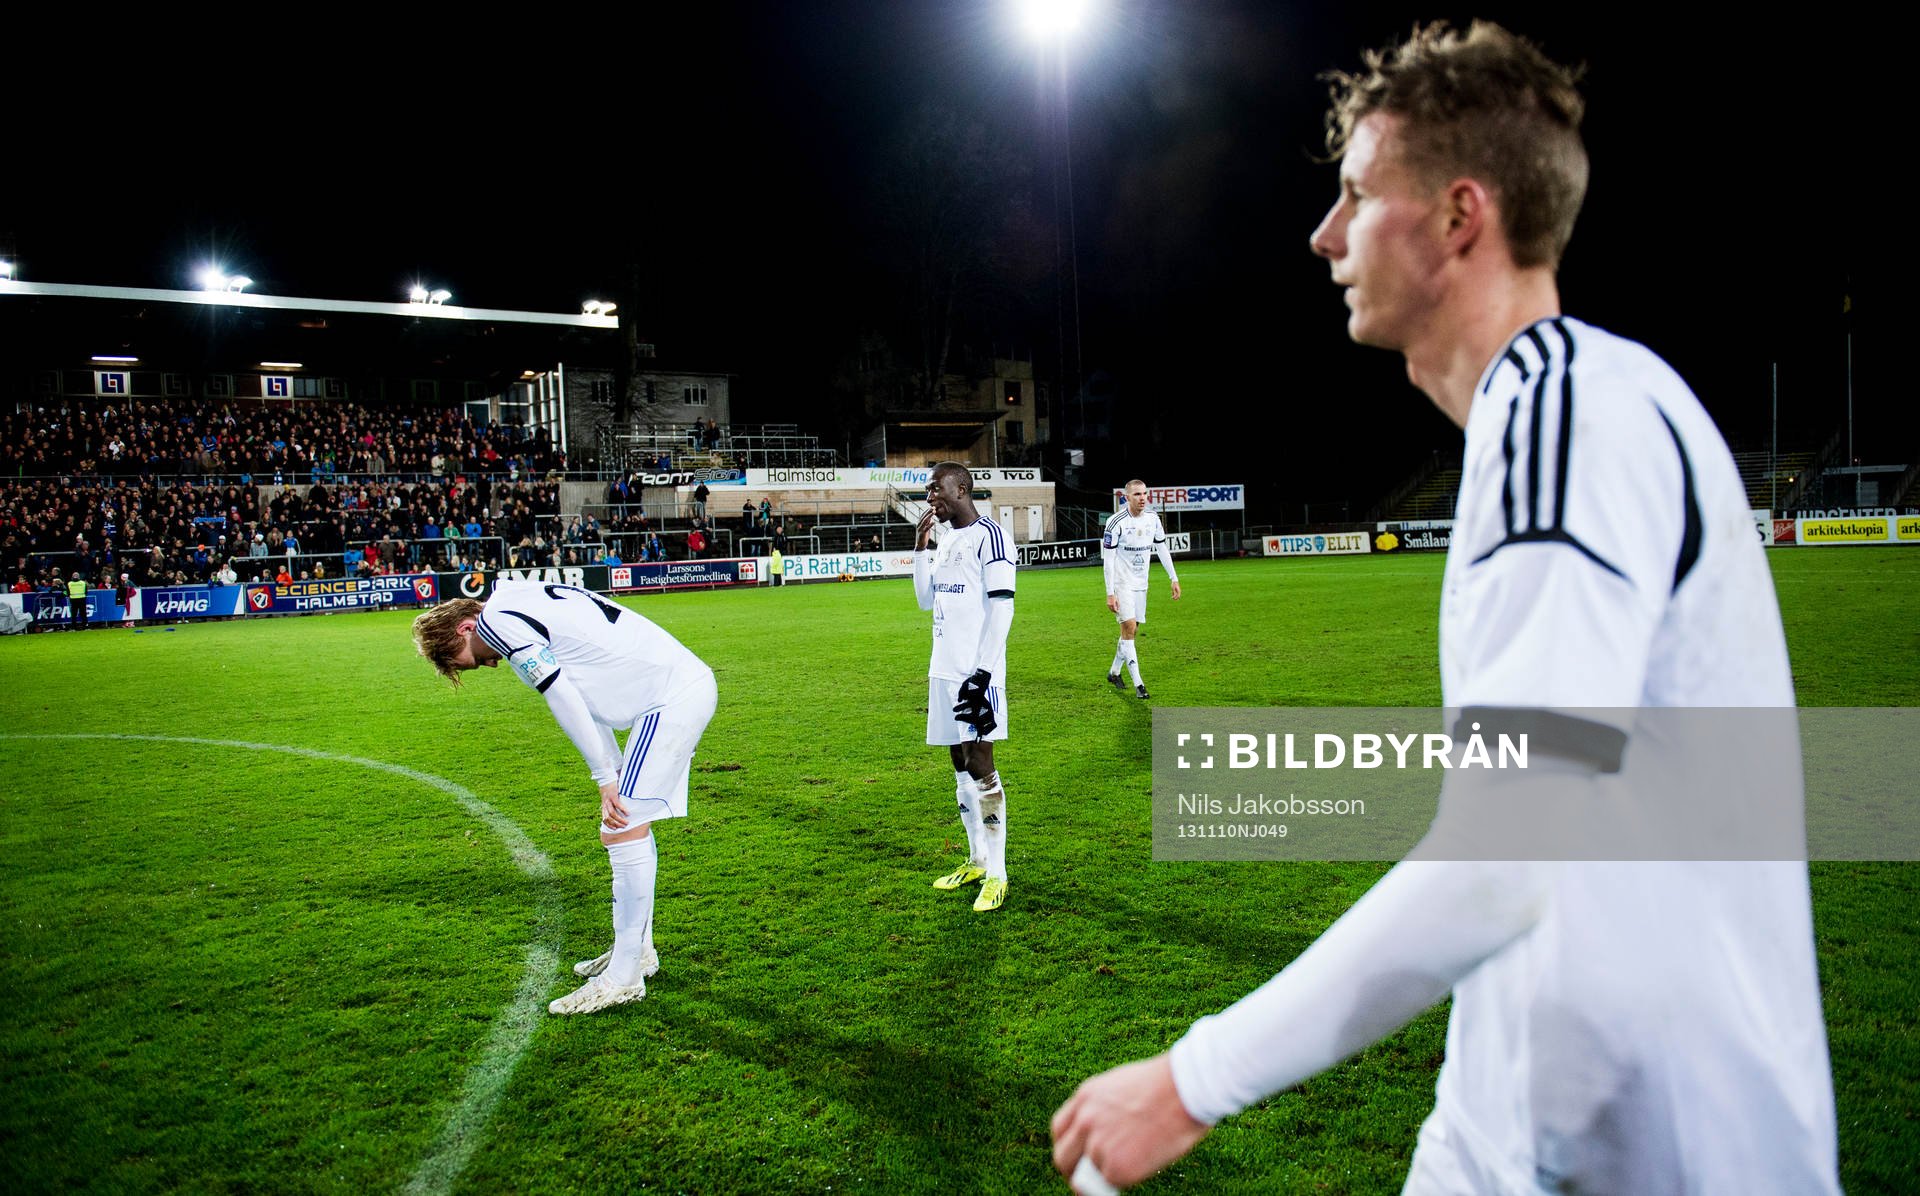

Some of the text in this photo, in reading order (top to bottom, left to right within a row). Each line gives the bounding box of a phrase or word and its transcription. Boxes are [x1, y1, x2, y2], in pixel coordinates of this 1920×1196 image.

[1000, 470, 1034, 480] TYLÖ
[1807, 523, 1883, 537] arkitektkopia
[1280, 535, 1361, 552] TIPS ELIT
[1041, 546, 1087, 561] MÅLERI
[667, 564, 706, 574] Larssons
[783, 557, 803, 577] På
[808, 558, 841, 575] Rätt
[845, 556, 883, 574] Plats
[640, 571, 732, 586] Fastighetsförmedling
[275, 577, 412, 597] SCIENCEPARK
[154, 598, 209, 615] KPMG
[295, 591, 394, 611] HALMSTAD
